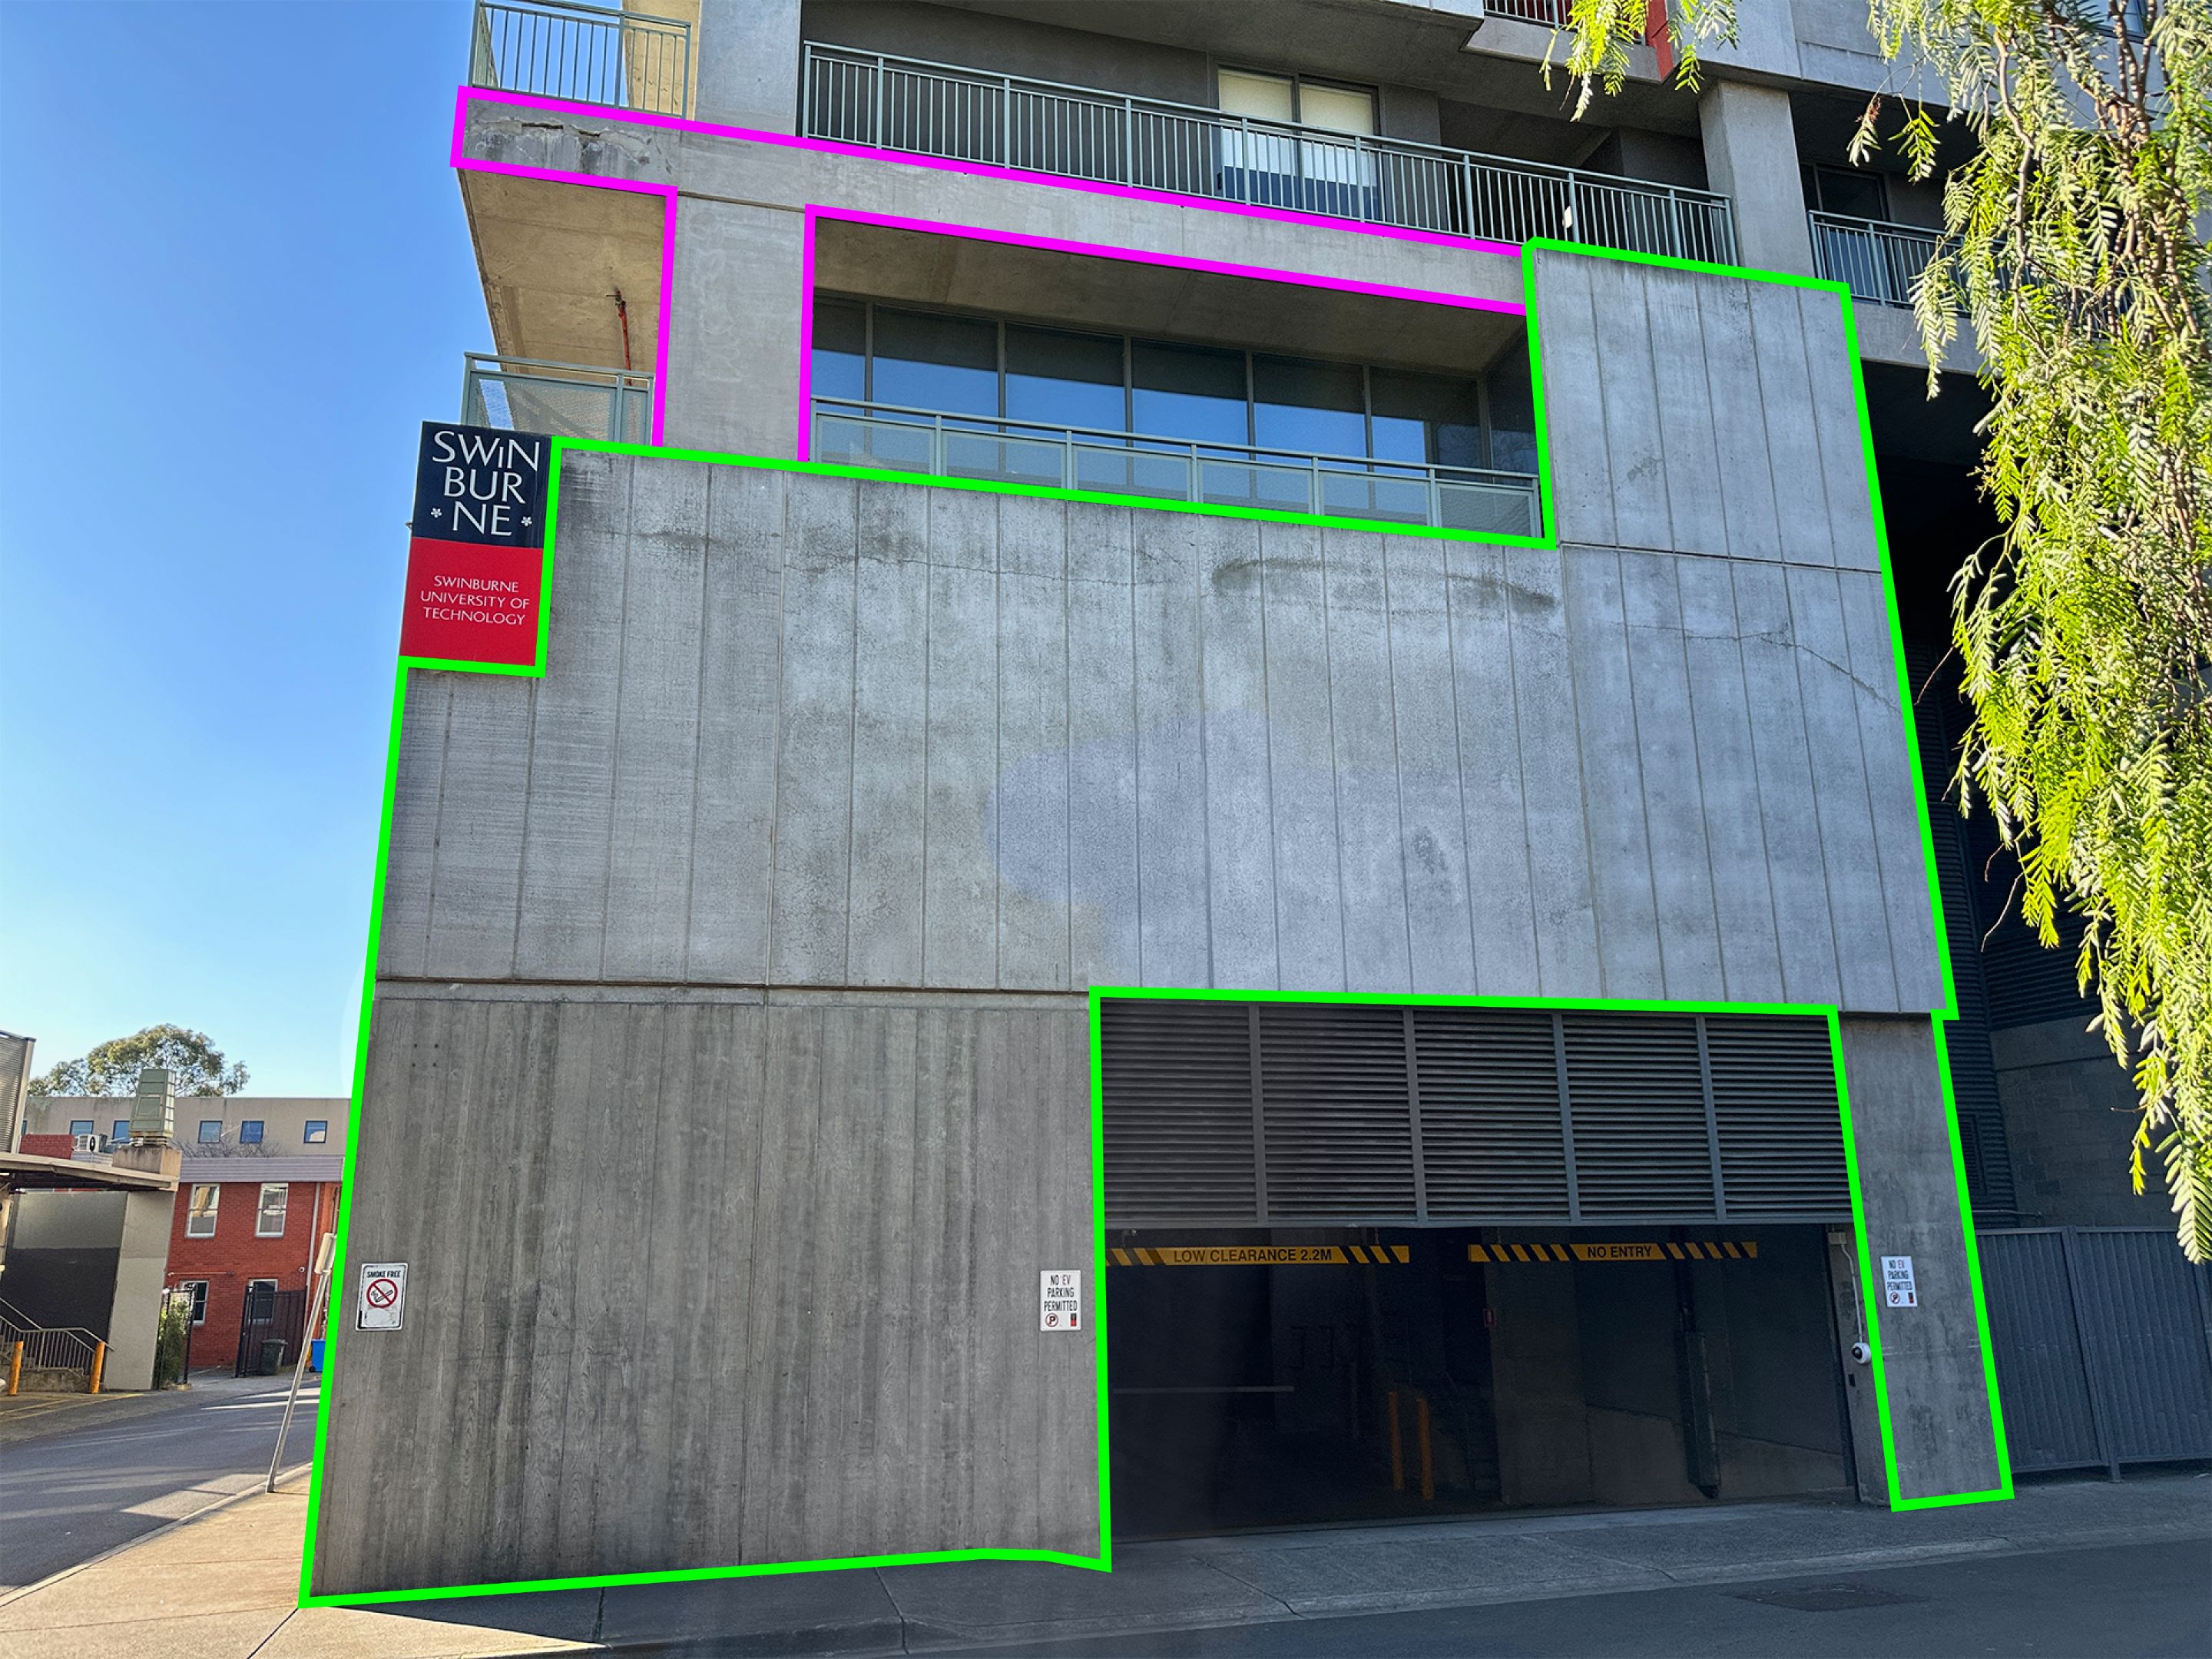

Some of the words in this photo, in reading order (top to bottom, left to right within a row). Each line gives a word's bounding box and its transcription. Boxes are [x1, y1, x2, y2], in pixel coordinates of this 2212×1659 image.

[443, 466, 526, 505] BUR
[452, 501, 512, 536] NE
[433, 575, 519, 593] SWINBURNE
[420, 590, 506, 608] UNIVERSITY
[510, 597, 530, 609] OF
[423, 606, 525, 625] TECHNOLOGY
[1174, 1250, 1206, 1263] LOW
[1210, 1249, 1296, 1263] CLEARANCE
[1300, 1248, 1332, 1262] 2.2M
[1587, 1246, 1607, 1258] NO
[1610, 1245, 1652, 1258] ENTRY
[1050, 1274, 1059, 1286] NO
[1062, 1274, 1071, 1286] EV
[1047, 1286, 1075, 1297] PARKING
[1044, 1300, 1078, 1311] PERMITTED
